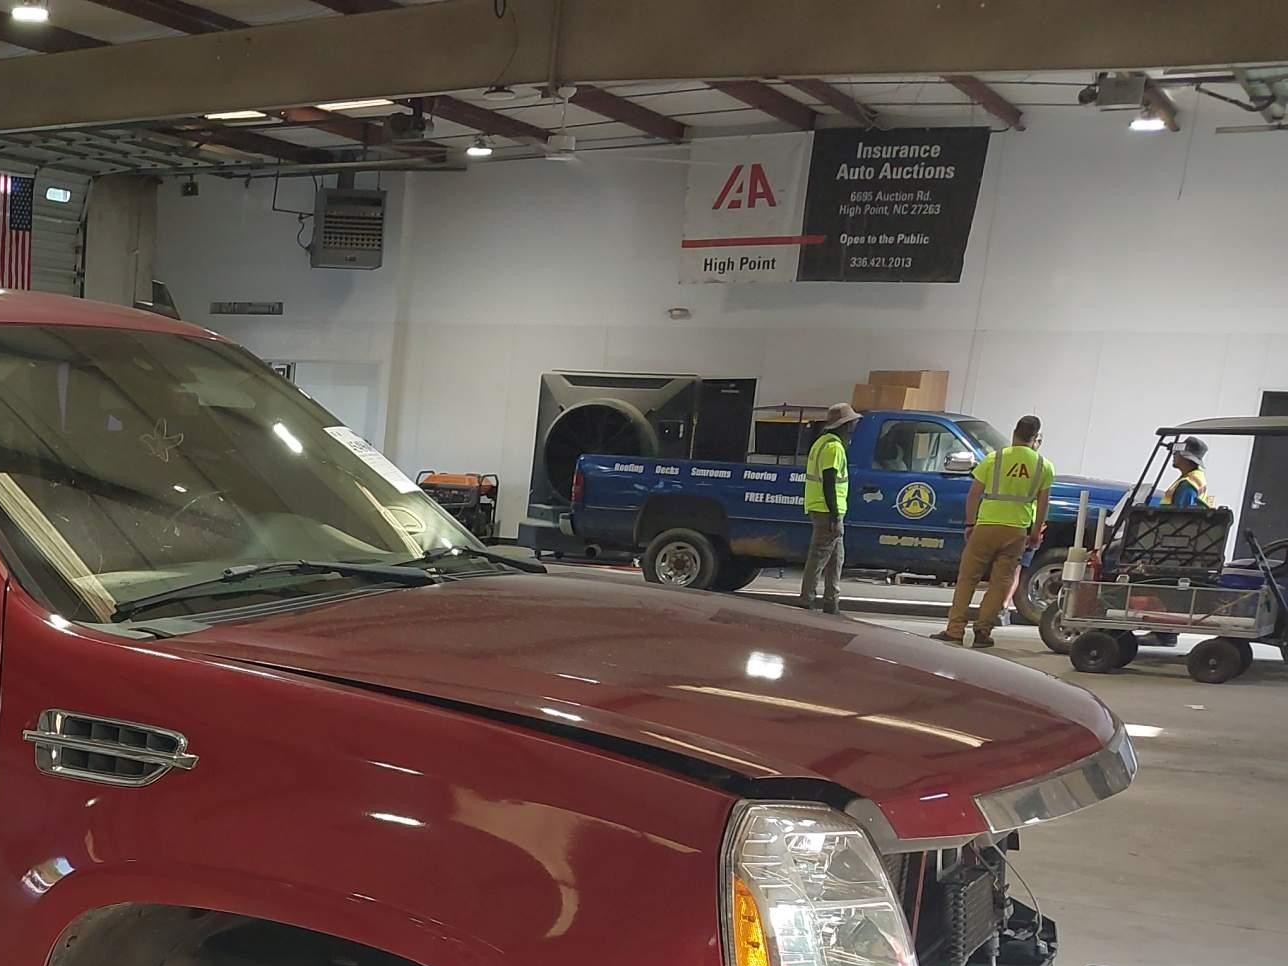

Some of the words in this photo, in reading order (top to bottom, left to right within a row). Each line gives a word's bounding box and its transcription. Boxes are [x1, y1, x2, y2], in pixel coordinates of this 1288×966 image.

[857, 141, 941, 159] Insurance
[836, 163, 874, 180] Auto
[878, 162, 955, 179] Auctions
[875, 190, 914, 201] Auction
[916, 190, 932, 201] Rd.
[839, 204, 862, 217] High
[863, 204, 889, 216] Point,
[893, 204, 909, 215] NC
[910, 203, 941, 215] 27263
[839, 233, 865, 246] Open
[867, 234, 877, 244] to
[878, 233, 895, 244] the
[896, 233, 929, 244] Public
[704, 257, 735, 275] High
[739, 256, 777, 271] Point
[614, 463, 644, 473] Roofing
[655, 465, 679, 475] Decks
[691, 467, 731, 478] Sunrooms
[743, 470, 777, 482] Flooring
[789, 473, 807, 482] Sidi
[744, 492, 765, 502] FREE
[765, 493, 805, 505] Estimate
